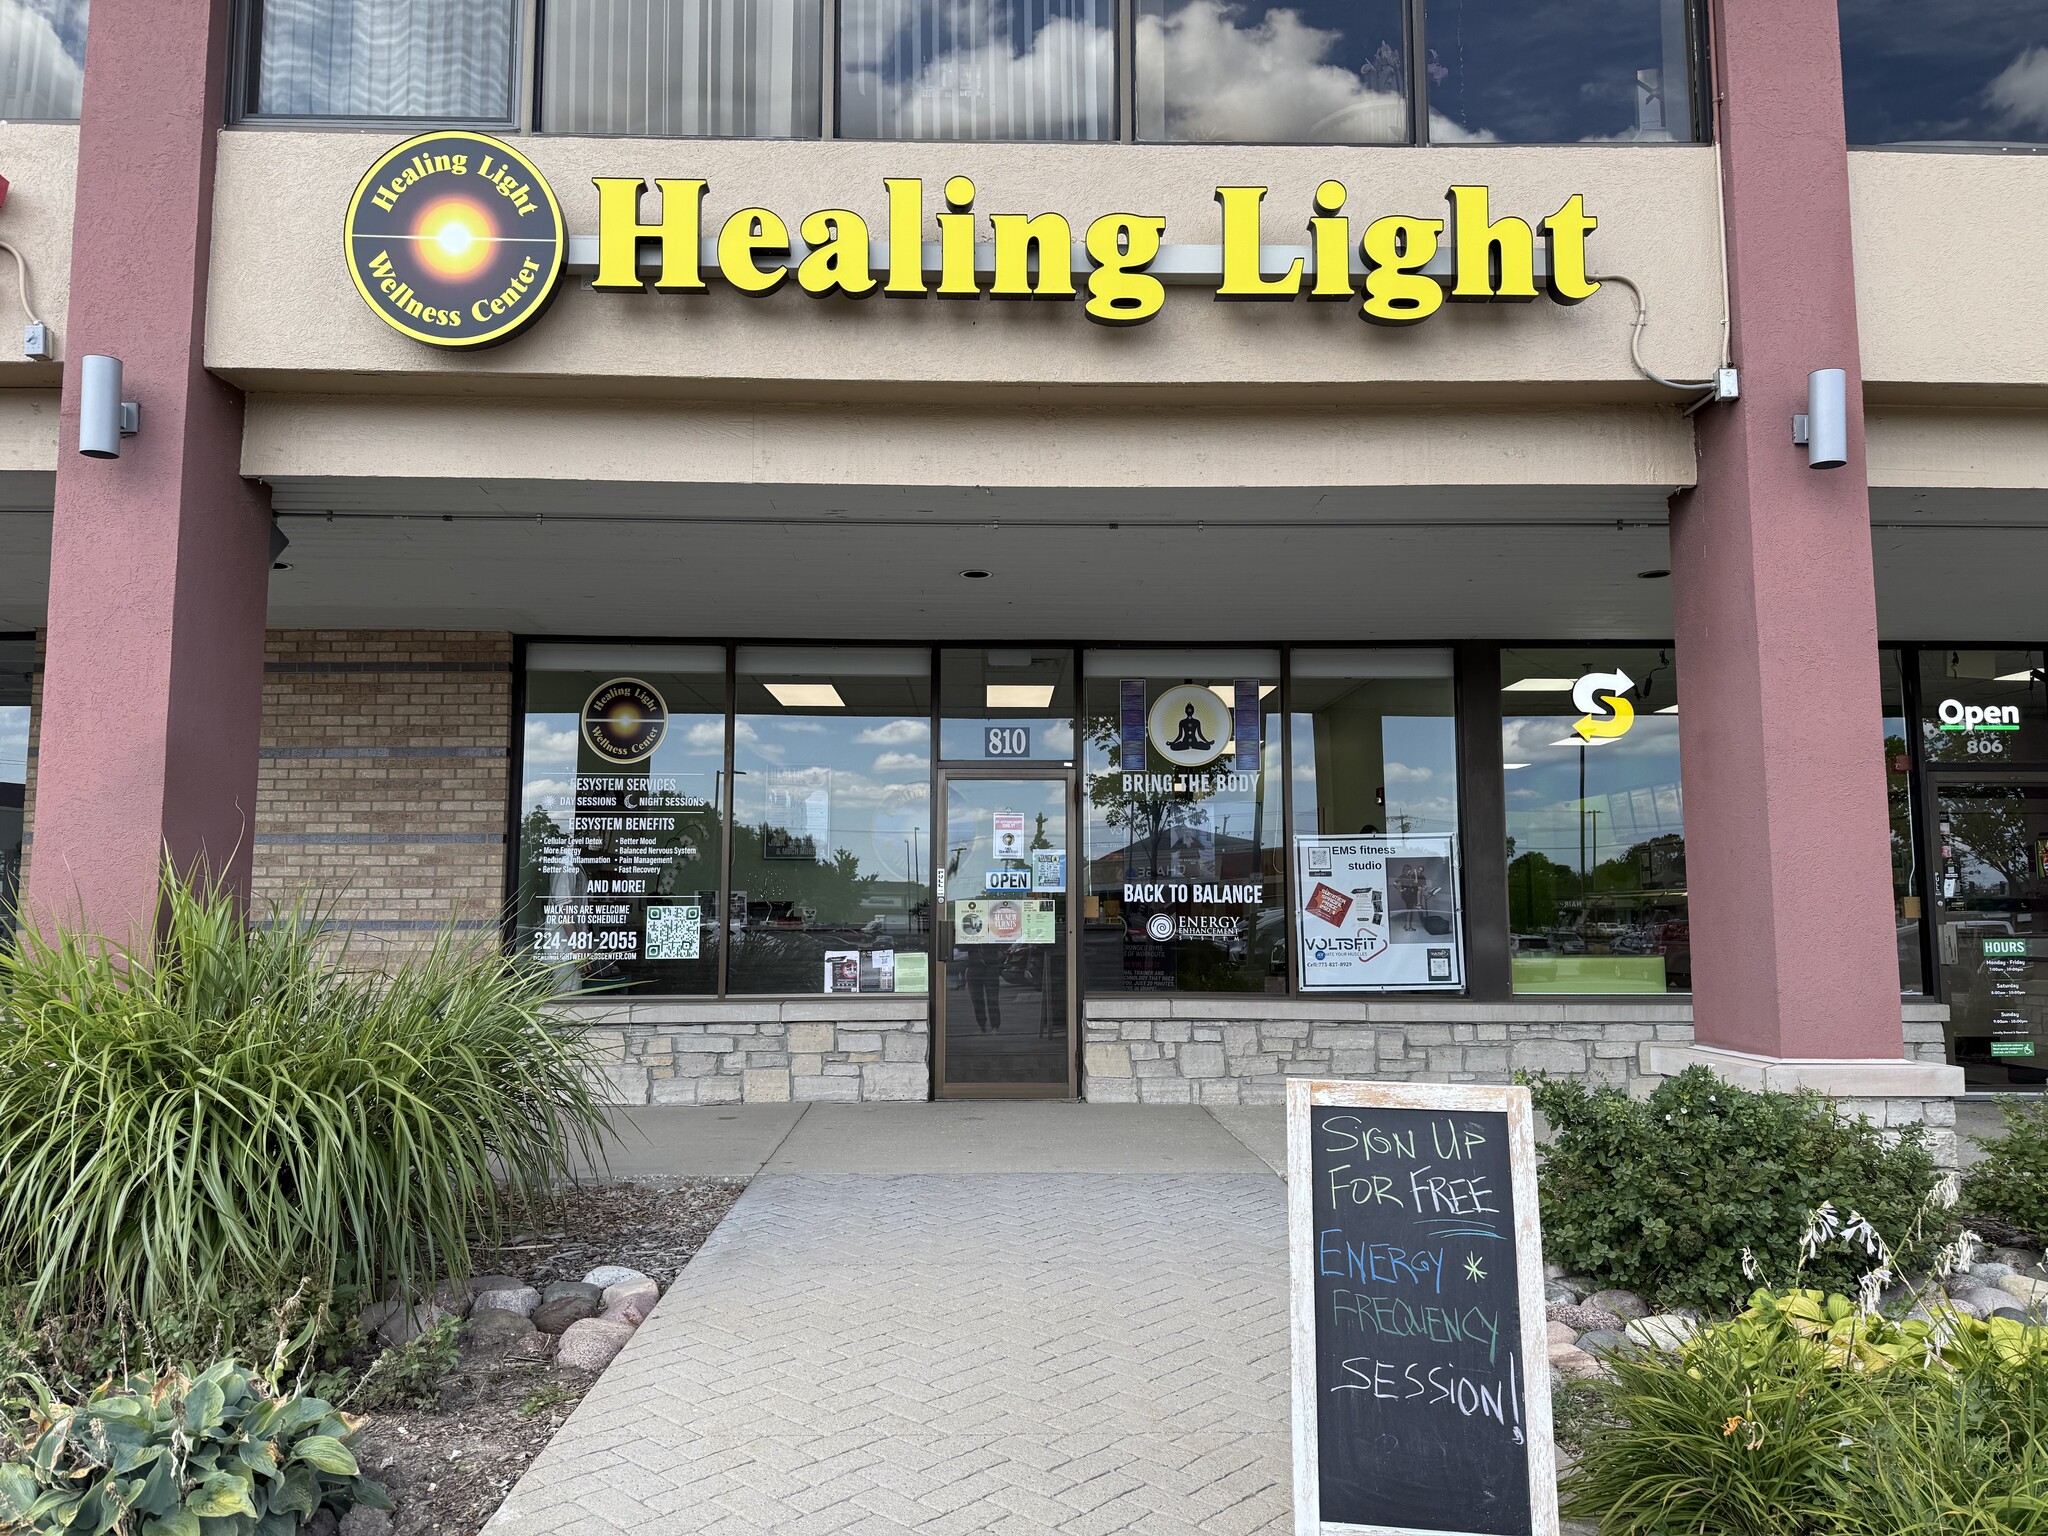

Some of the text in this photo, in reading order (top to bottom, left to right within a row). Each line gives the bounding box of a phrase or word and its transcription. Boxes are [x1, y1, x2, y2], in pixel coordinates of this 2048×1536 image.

[371, 152, 538, 217] Healing Light
[592, 175, 1602, 322] Healing Light
[368, 250, 540, 326] Wellness Center
[593, 687, 658, 712] Healing Light
[1938, 699, 2020, 731] Open
[592, 725, 658, 755] Wellness Center
[989, 728, 1026, 754] 810
[1966, 740, 2003, 754] 806
[626, 778, 676, 791] SERVICES
[1122, 774, 1260, 792] BRING THE BODY
[560, 797, 617, 806] DAY SESSIONS
[639, 797, 704, 807] NIGHT SESSIONS
[625, 817, 675, 830] BENEFITS
[543, 837, 603, 845] Cellular Level Detox
[619, 837, 657, 845] Better Mood
[560, 847, 581, 856] Energy
[619, 847, 697, 856] Balanced Nervous System
[1332, 845, 1396, 855] EMS fitness
[543, 856, 570, 864] Reduced
[619, 856, 673, 866] Pain Management
[1348, 861, 1382, 871] studio
[543, 866, 580, 876] Better Sleep
[633, 866, 661, 875] Recovery
[587, 880, 646, 893] AND MORE!
[990, 873, 1027, 888] OPEN
[1123, 884, 1263, 904] BACK TO BALANCE
[543, 905, 630, 914] WALK-INS ARE WELCOME
[546, 915, 627, 924] OR CALL TO SCHEDULE!
[1179, 916, 1240, 928] ENERGY
[534, 931, 637, 949] 224-481-2055
[1984, 942, 2025, 952] HOURS
[1322, 1115, 1486, 1161] SIGN UP
[1328, 1164, 1500, 1214] FOR FREE
[1320, 1228, 1444, 1294] ENERGY
[1332, 1289, 1500, 1364] FREQUENCY
